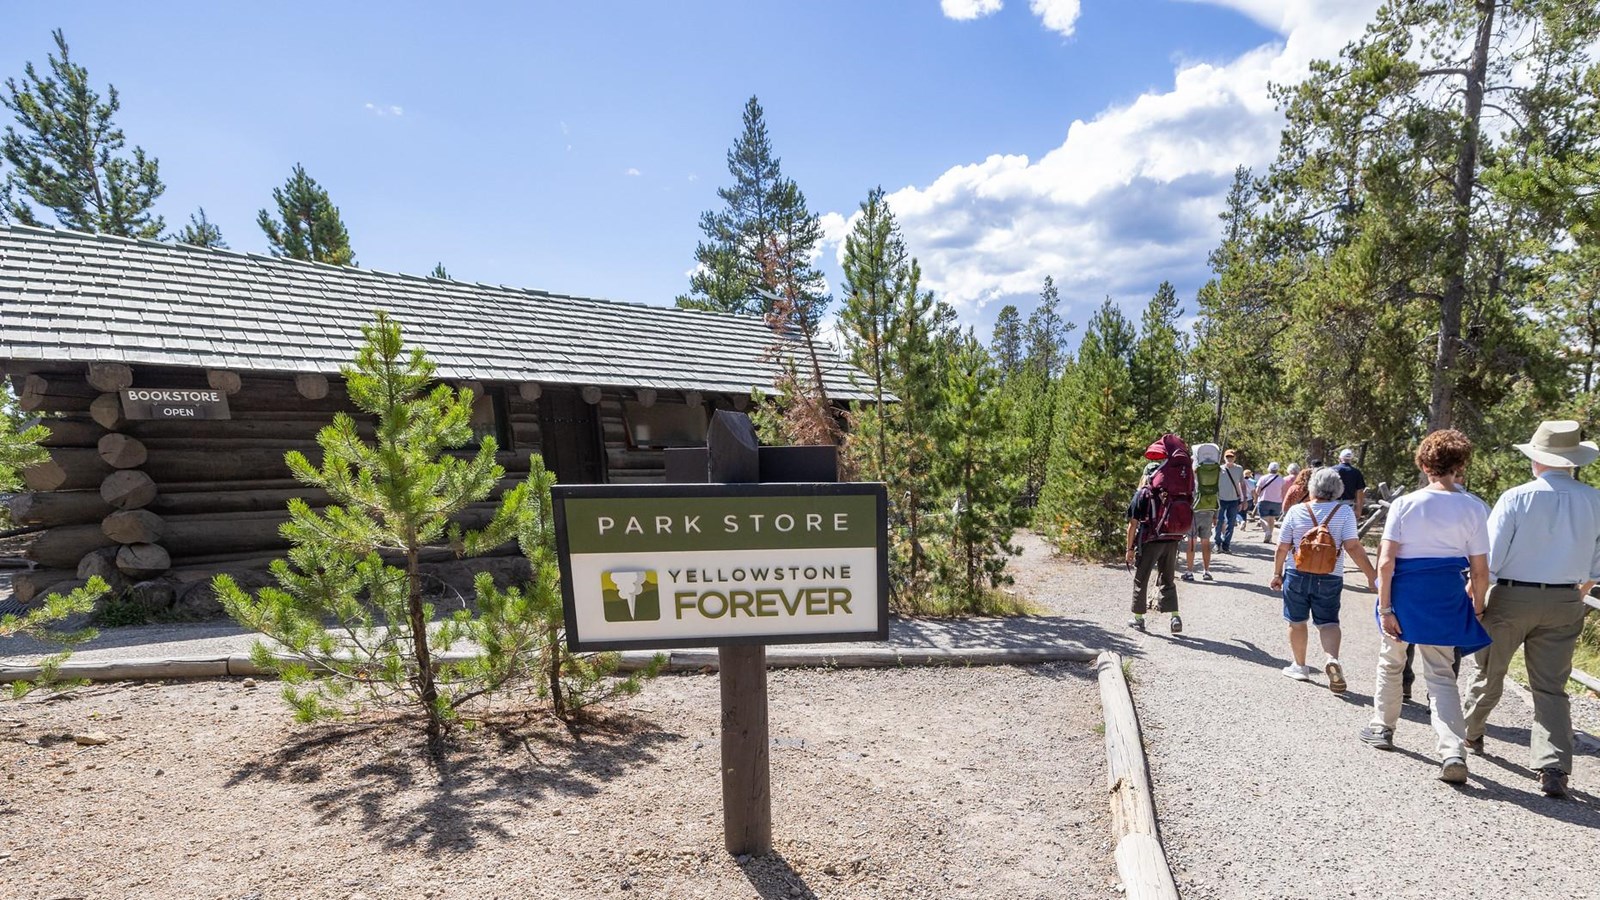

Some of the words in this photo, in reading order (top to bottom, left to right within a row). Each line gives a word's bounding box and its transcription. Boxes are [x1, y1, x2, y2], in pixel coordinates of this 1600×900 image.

[128, 390, 220, 402] BOOKSTORE
[163, 408, 194, 417] OPEN
[597, 515, 702, 535] PARK
[724, 513, 849, 533] STORE
[668, 566, 852, 584] YELLOWSTONE
[674, 587, 853, 620] FOREVER
